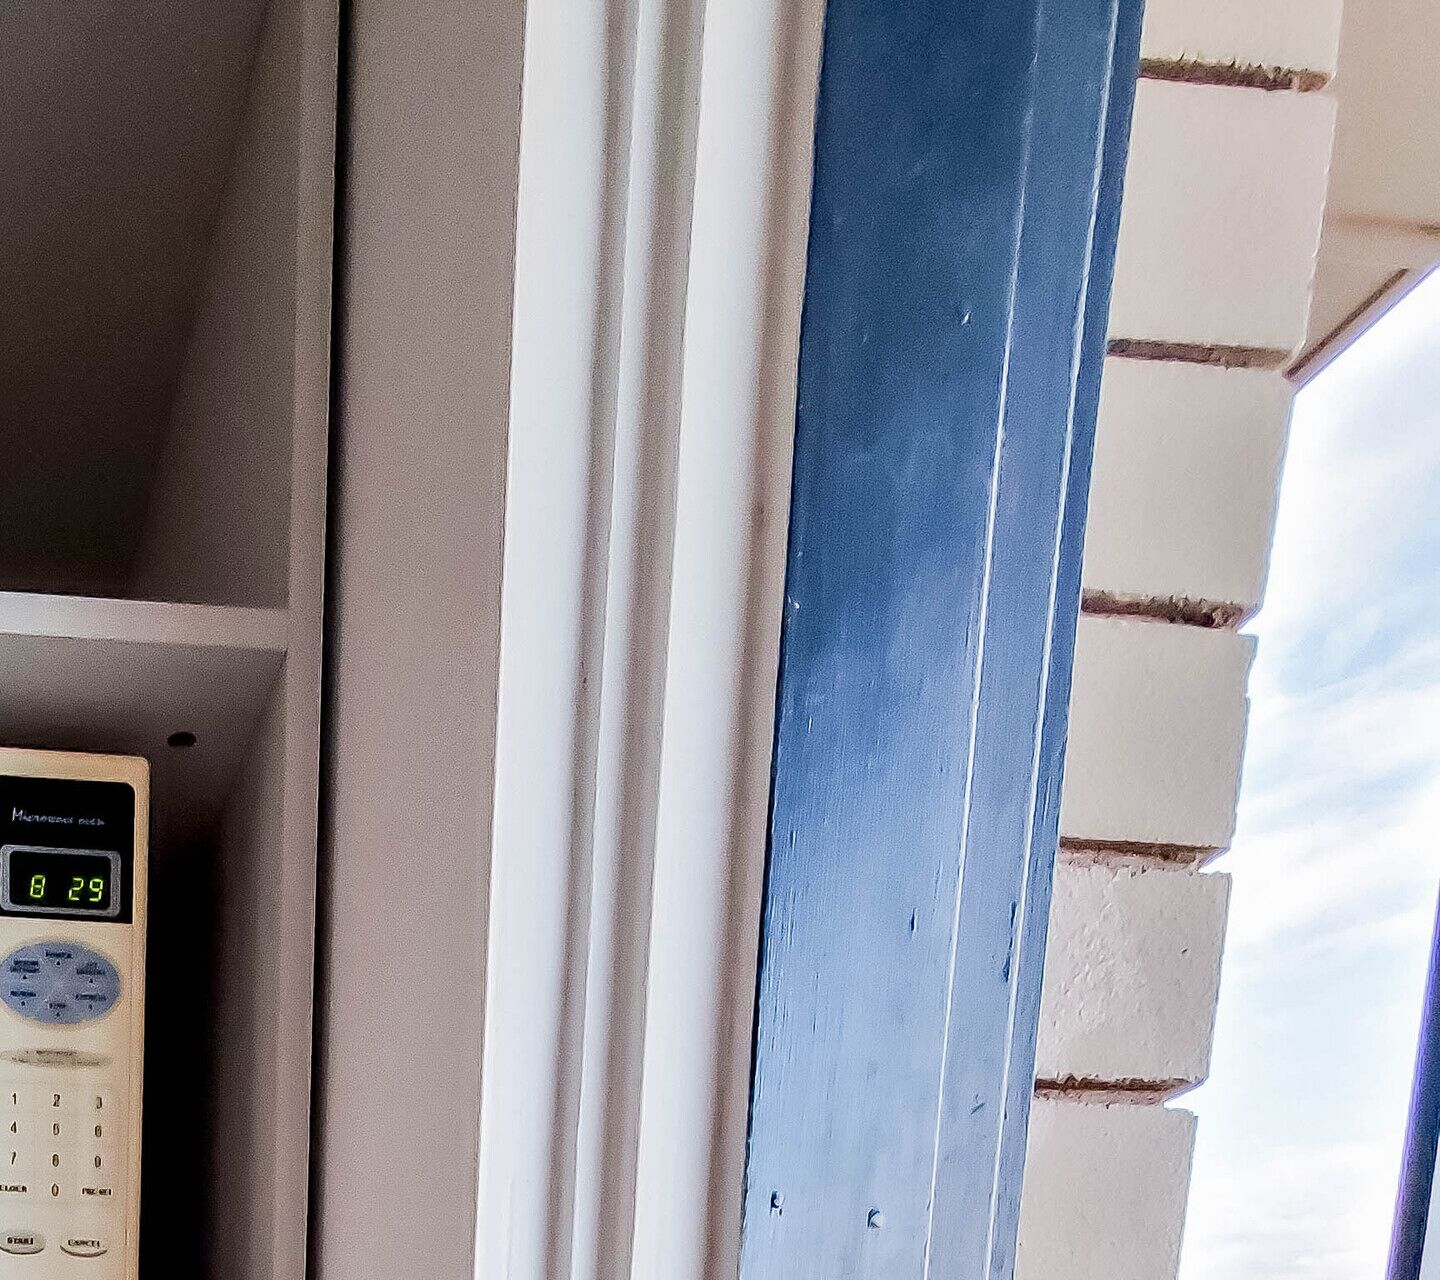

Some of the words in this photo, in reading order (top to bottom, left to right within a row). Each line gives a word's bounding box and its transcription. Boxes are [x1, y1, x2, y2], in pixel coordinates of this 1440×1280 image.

[29, 874, 46, 898] 8
[68, 877, 104, 902] 29
[52, 1093, 61, 1108] 2
[10, 1120, 17, 1134] 4
[51, 1183, 59, 1197] 0
